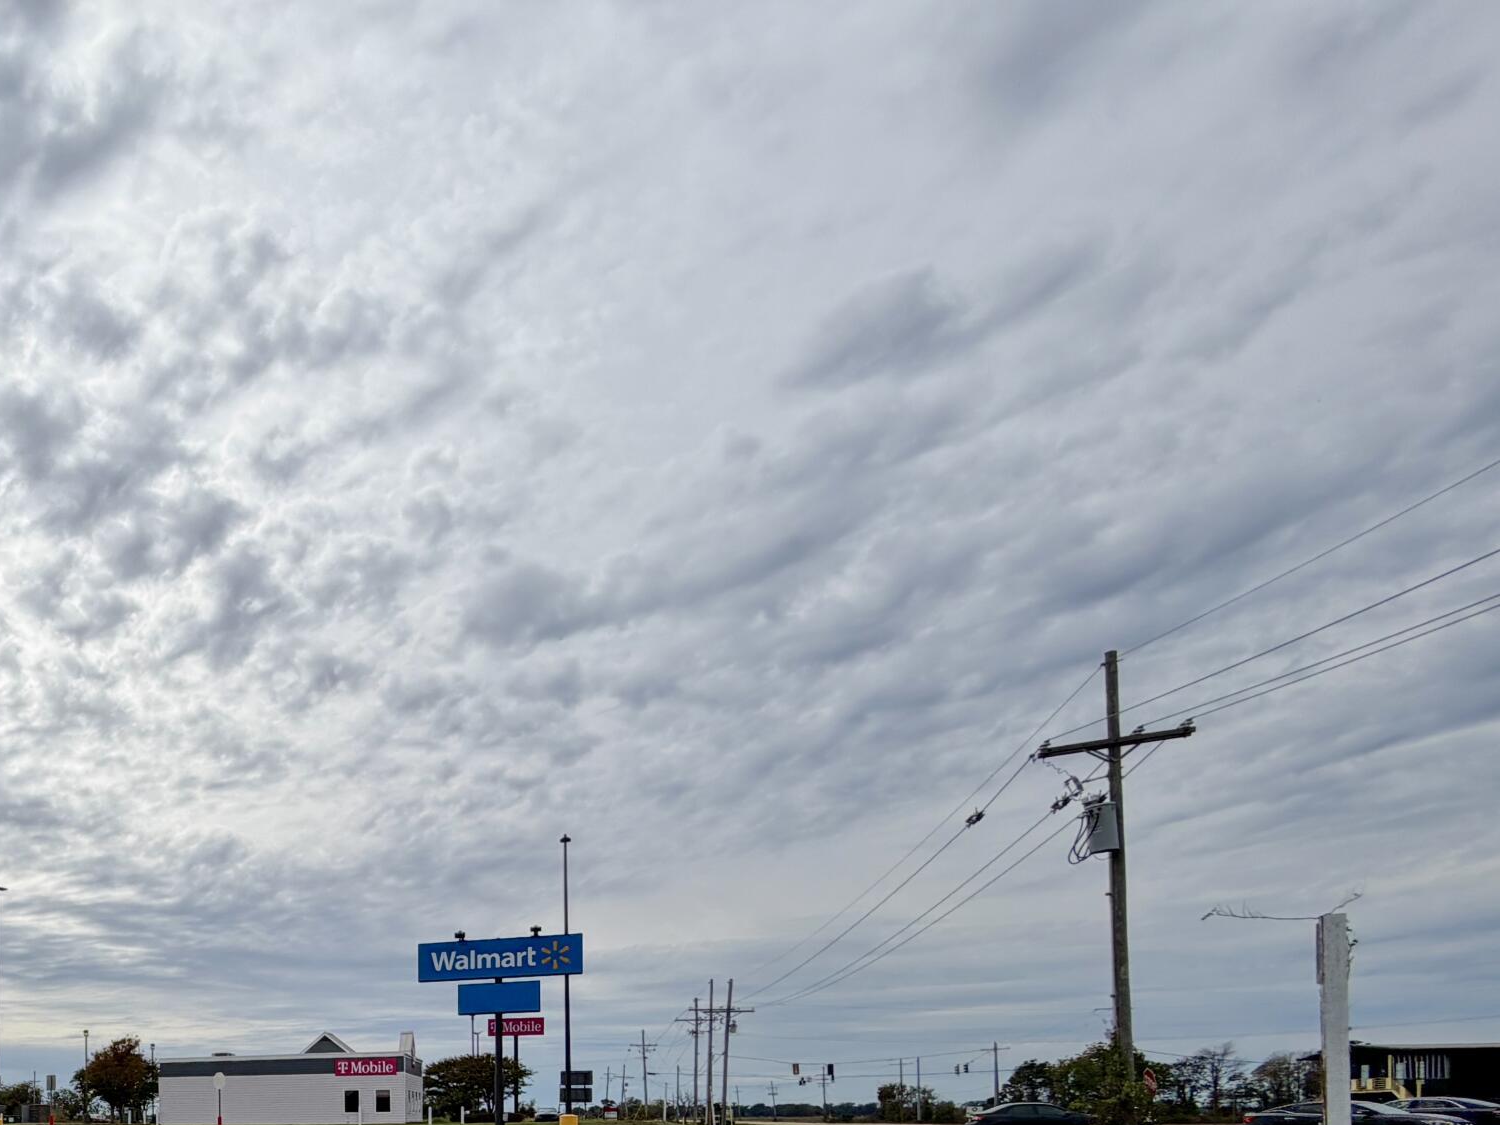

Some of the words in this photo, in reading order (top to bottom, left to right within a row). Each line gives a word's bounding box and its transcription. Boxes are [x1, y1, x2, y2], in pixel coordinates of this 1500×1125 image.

[431, 946, 537, 972] Walmart
[502, 1020, 541, 1033] Mobile
[350, 1060, 394, 1074] Mobile
